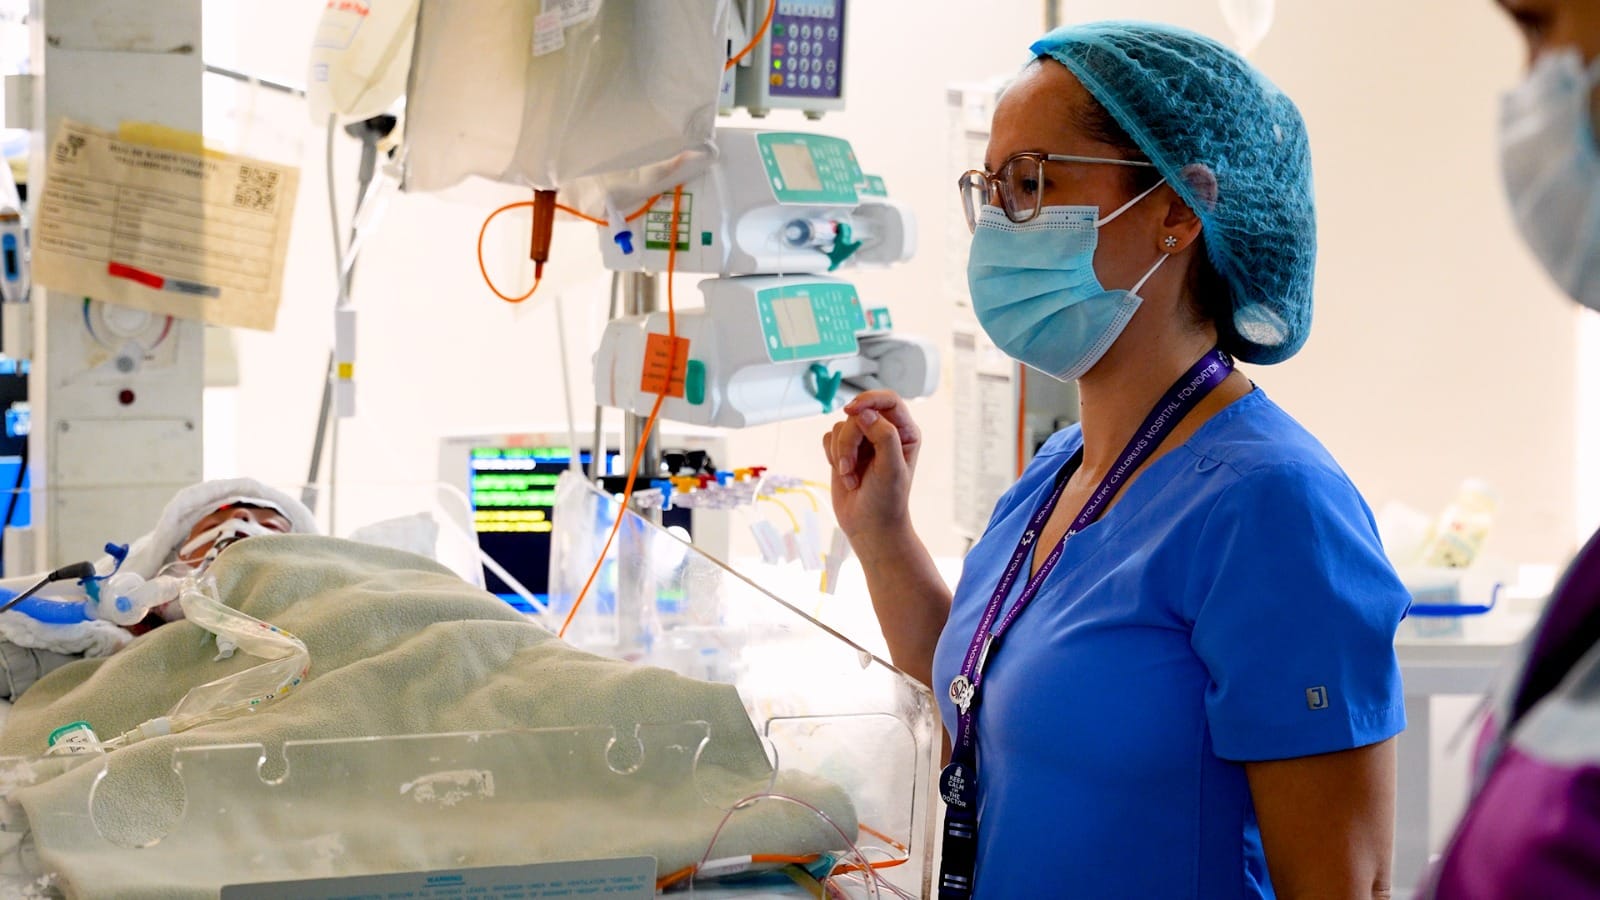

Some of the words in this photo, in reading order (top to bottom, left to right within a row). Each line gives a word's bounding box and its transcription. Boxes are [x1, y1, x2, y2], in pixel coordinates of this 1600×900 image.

[1078, 483, 1111, 524] STOLLERY
[1110, 438, 1148, 484] CHILDREN'S
[1145, 400, 1180, 439] HOSPITAL
[1177, 361, 1219, 401] FOUNDATION
[999, 552, 1023, 593] STOLLERY
[1020, 551, 1060, 602] FOUNDATION
[948, 781, 965, 791] CALM
[950, 775, 965, 784] KEEP
[942, 794, 967, 808] DOCTOR
[949, 791, 960, 800] THE
